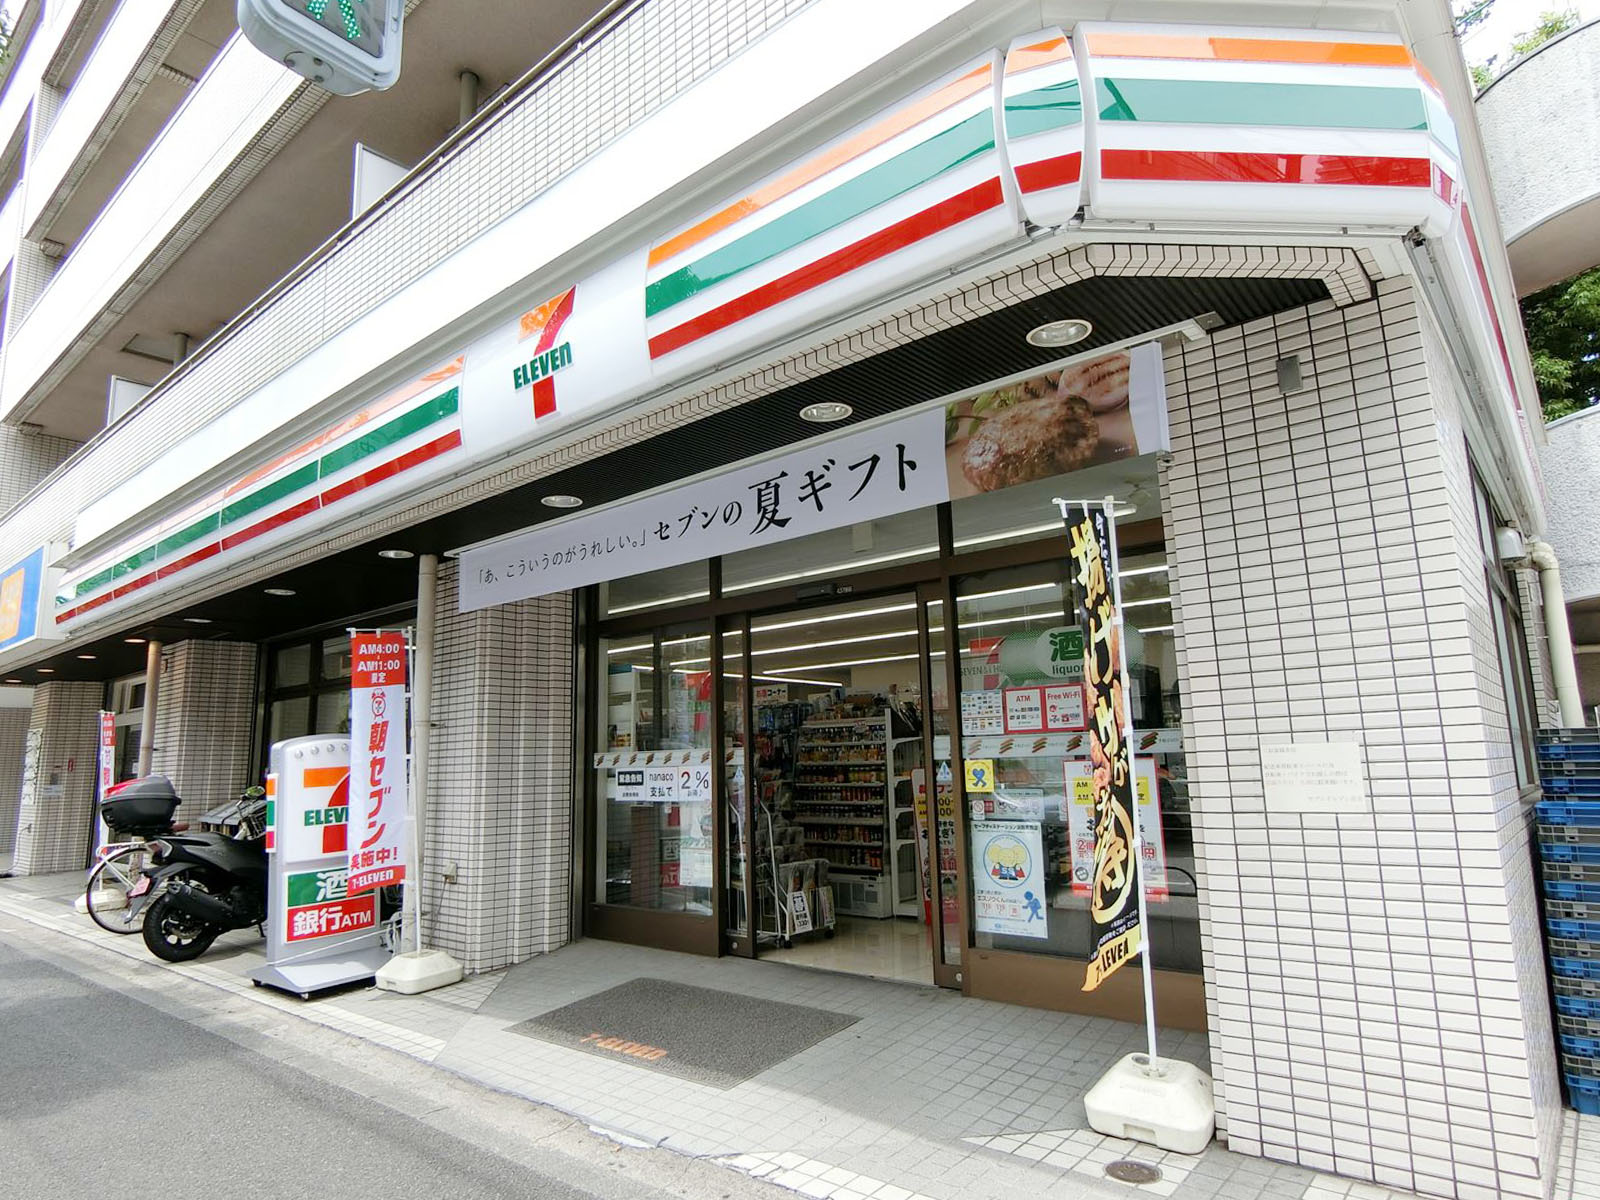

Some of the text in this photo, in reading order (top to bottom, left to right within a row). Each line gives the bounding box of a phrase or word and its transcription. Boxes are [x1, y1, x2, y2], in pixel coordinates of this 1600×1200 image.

[652, 442, 919, 542] セブンの夏ギフト
[359, 643, 400, 655] AM4:00
[1048, 630, 1084, 662] 酒
[357, 659, 401, 672] AM11:00
[360, 720, 391, 849] 朝セブン
[649, 772, 674, 782] nanaco
[650, 786, 673, 798] 支払で
[304, 807, 348, 826] ELEV
[293, 905, 371, 938] 銀行ATM
